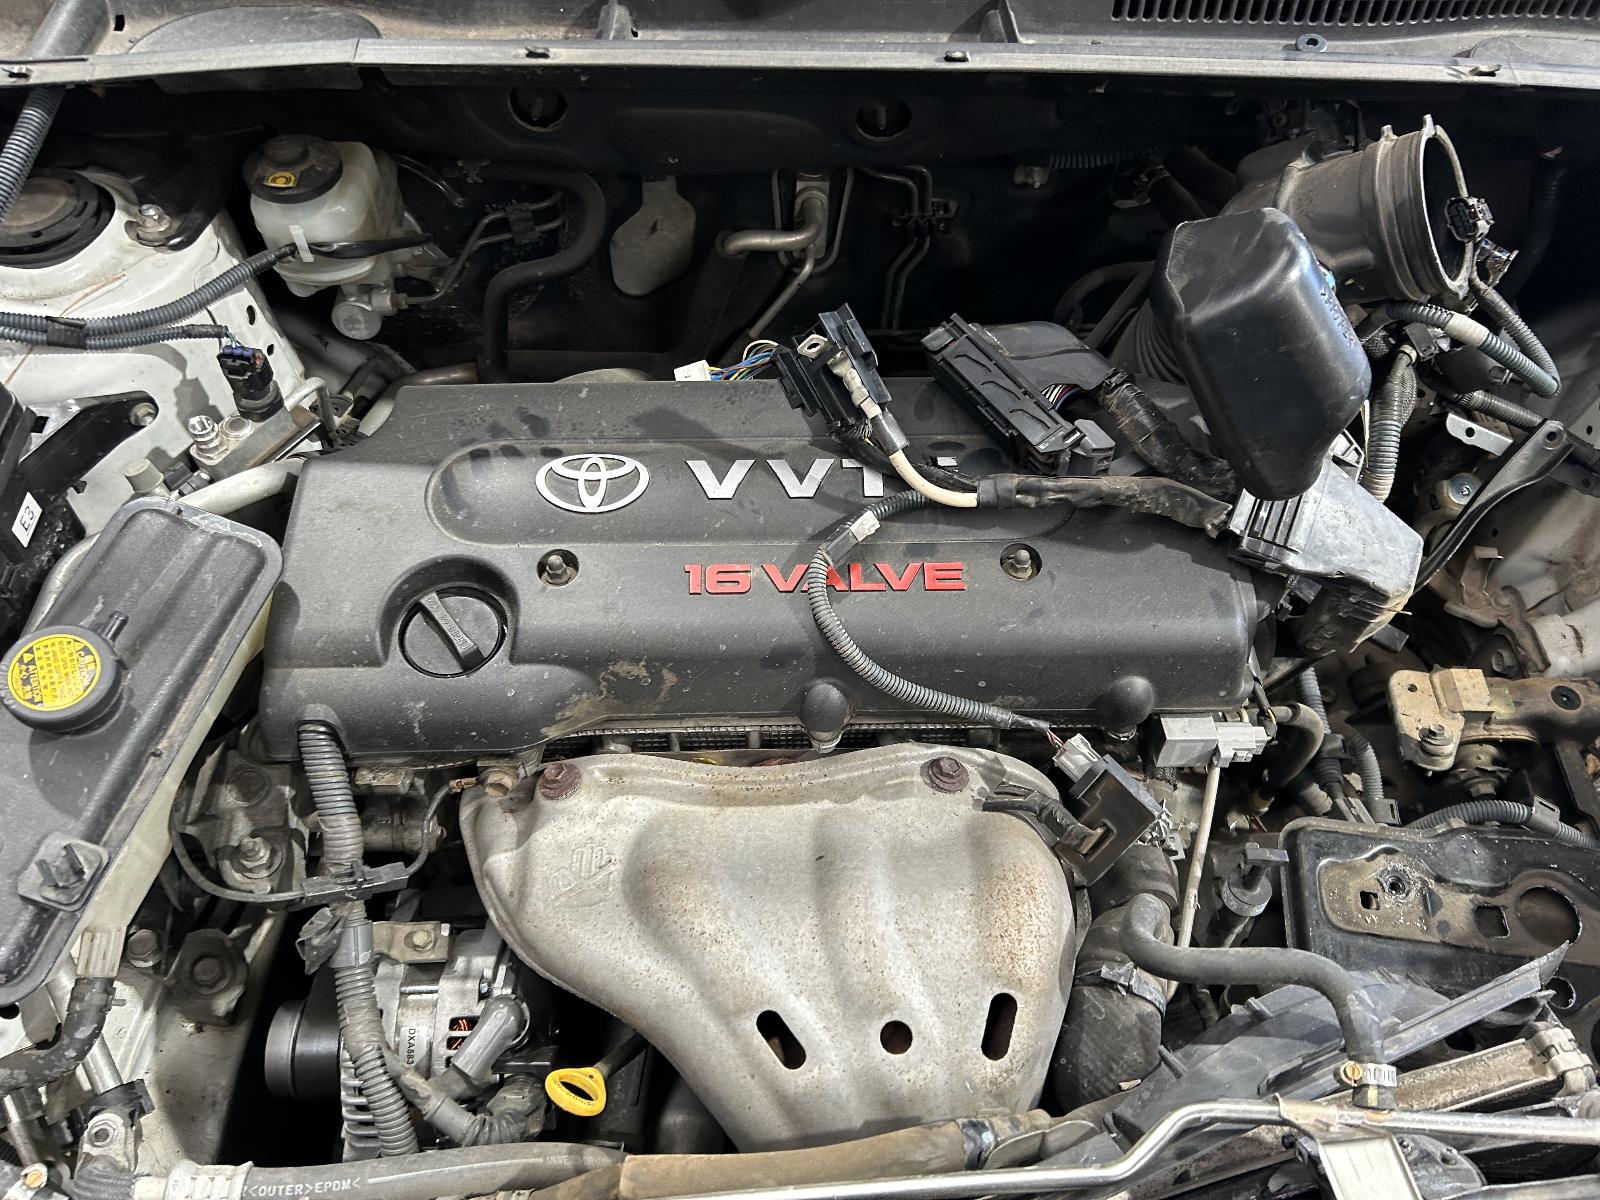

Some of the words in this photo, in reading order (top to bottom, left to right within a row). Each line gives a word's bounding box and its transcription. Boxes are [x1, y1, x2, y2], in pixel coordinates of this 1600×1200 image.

[685, 456, 958, 500] VVT
[20, 505, 35, 532] E3
[685, 563, 752, 595] 16
[762, 561, 966, 594] VALVE
[29, 665, 43, 702] ATTENTION
